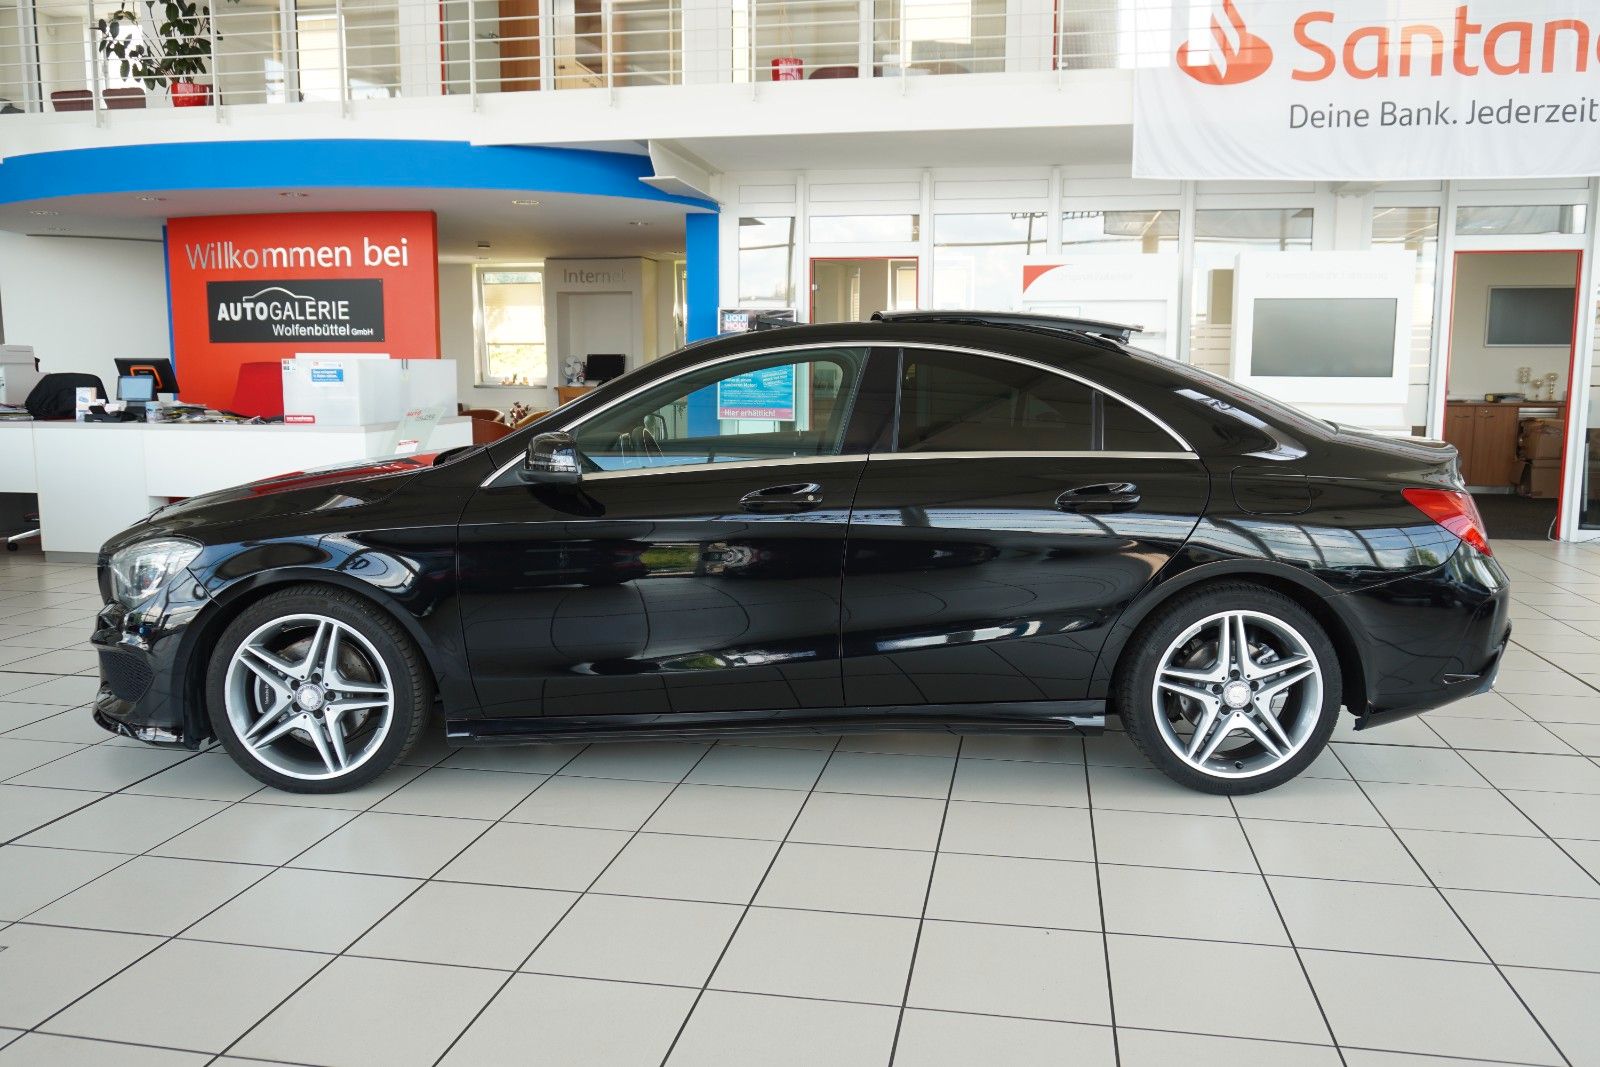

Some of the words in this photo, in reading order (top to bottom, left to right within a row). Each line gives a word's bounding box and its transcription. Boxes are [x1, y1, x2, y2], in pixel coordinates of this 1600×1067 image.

[1291, 4, 1600, 82] Santan
[1289, 103, 1370, 129] Deine
[1380, 100, 1458, 127] Bank.
[1465, 96, 1600, 125] Jederzeit
[185, 241, 352, 270] Willkommen
[363, 236, 409, 267] bei
[217, 300, 350, 322] AUTOGALERIE
[272, 323, 350, 337] Wolfenbüttel
[351, 328, 374, 336] GmbH
[725, 321, 748, 331] MOLY
[724, 408, 739, 417] Hier
[740, 408, 776, 417] erhältlich!
